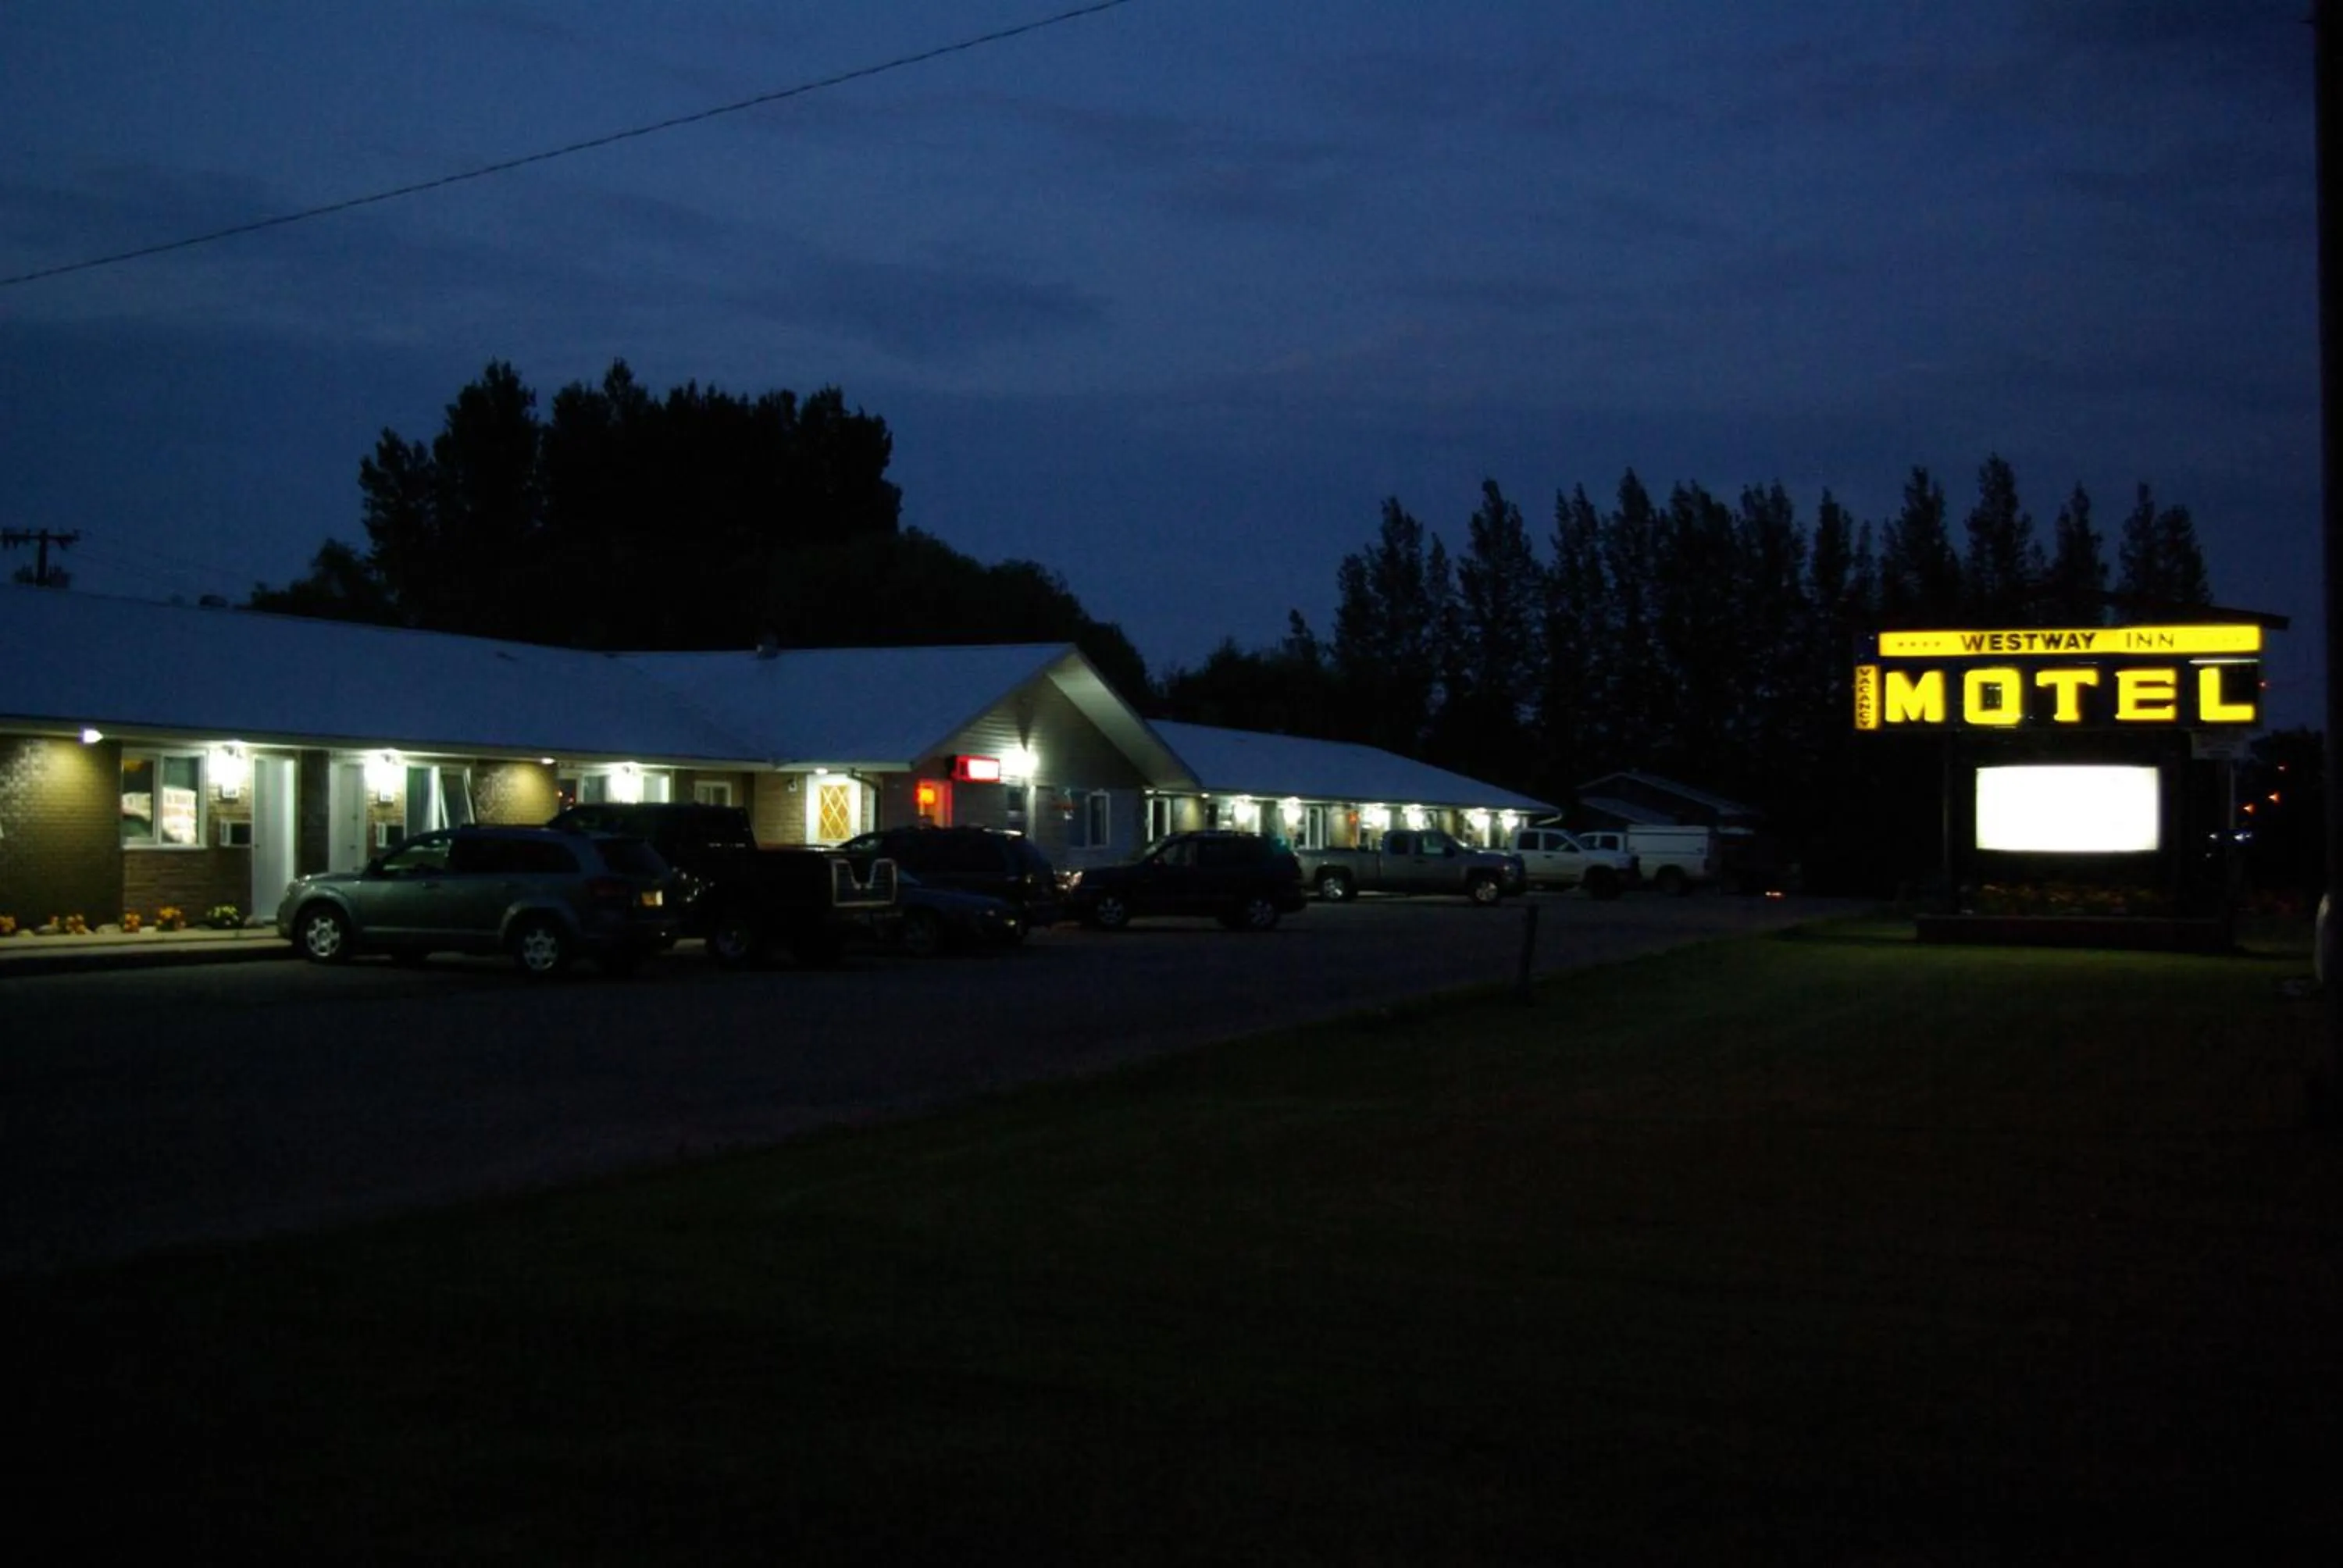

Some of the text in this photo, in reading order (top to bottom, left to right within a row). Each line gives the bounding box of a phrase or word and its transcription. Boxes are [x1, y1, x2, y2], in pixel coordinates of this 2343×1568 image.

[1960, 632, 2174, 651] WESTWAY INN
[1885, 667, 2255, 725] MOTEL
